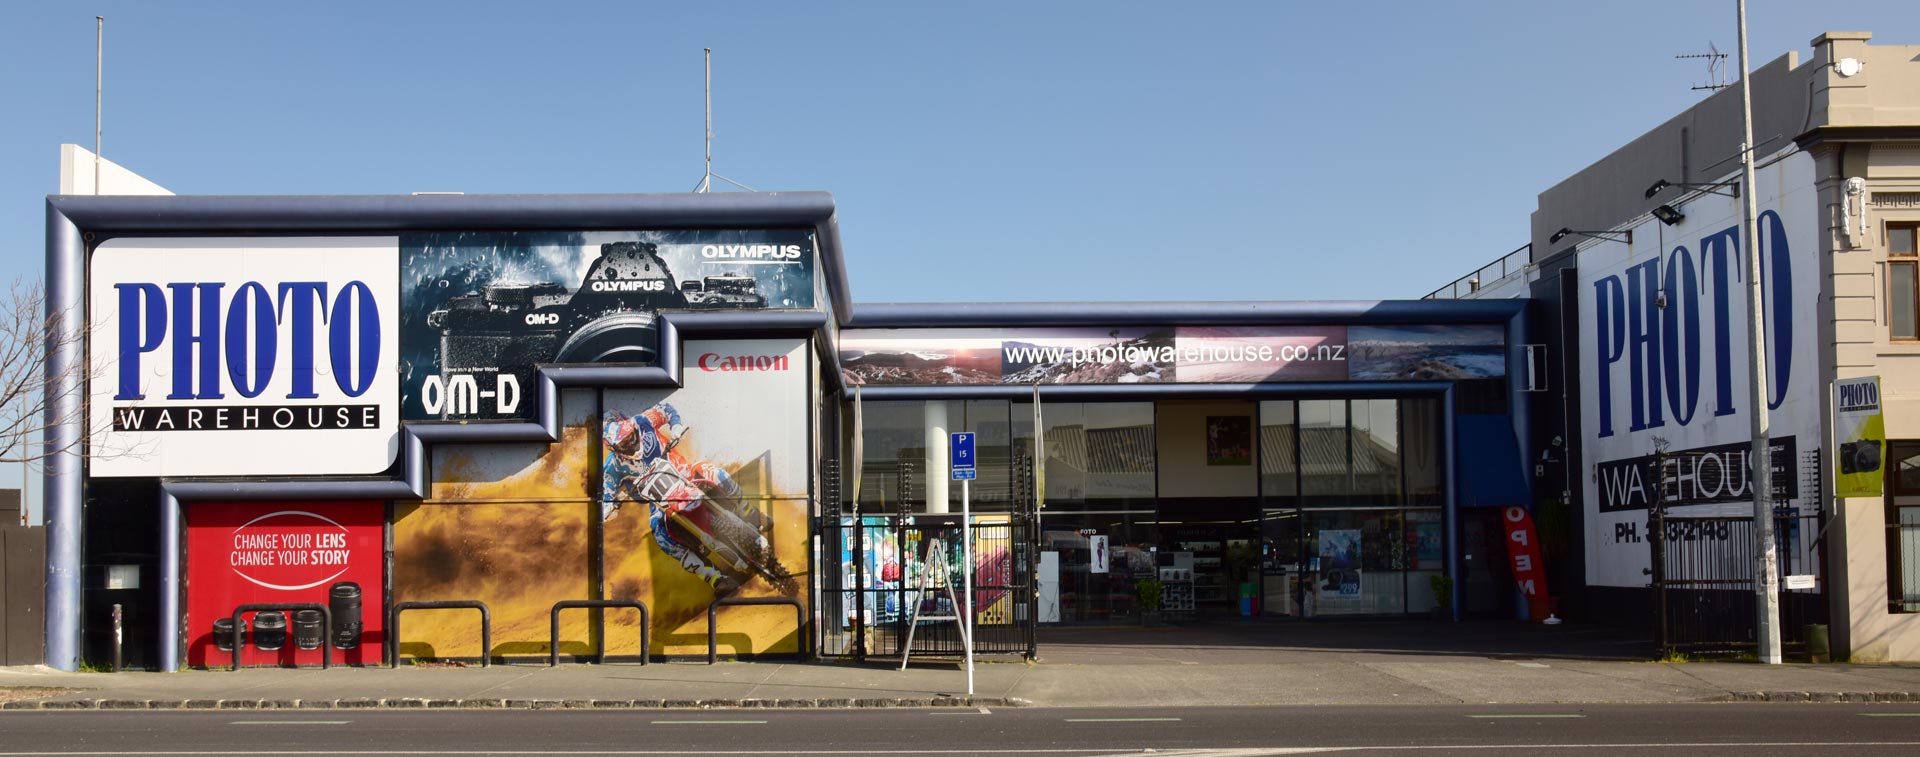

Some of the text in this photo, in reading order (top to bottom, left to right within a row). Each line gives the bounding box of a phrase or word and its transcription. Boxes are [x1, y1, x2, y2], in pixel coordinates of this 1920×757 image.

[701, 244, 801, 259] OLYMPUS
[591, 280, 665, 292] OLYMPUS
[525, 313, 559, 325] OM-D
[1594, 209, 1793, 438] PHOTO
[113, 280, 381, 400] PHOTO
[698, 352, 789, 372] Canon
[1005, 343, 1345, 368] www.photowarehouse.co.nz
[421, 374, 520, 414] OM-D
[1840, 382, 1877, 406] PHOTO
[120, 407, 375, 430] WAREHOUSE
[959, 434, 967, 444] P
[959, 450, 967, 458] 15
[1603, 444, 1785, 507] WAEHOUE
[234, 533, 346, 549] CHANGE YOUR LENS
[1615, 520, 1729, 544] PH. 3-2148
[231, 550, 350, 566] CHANGE YOUR STORY
